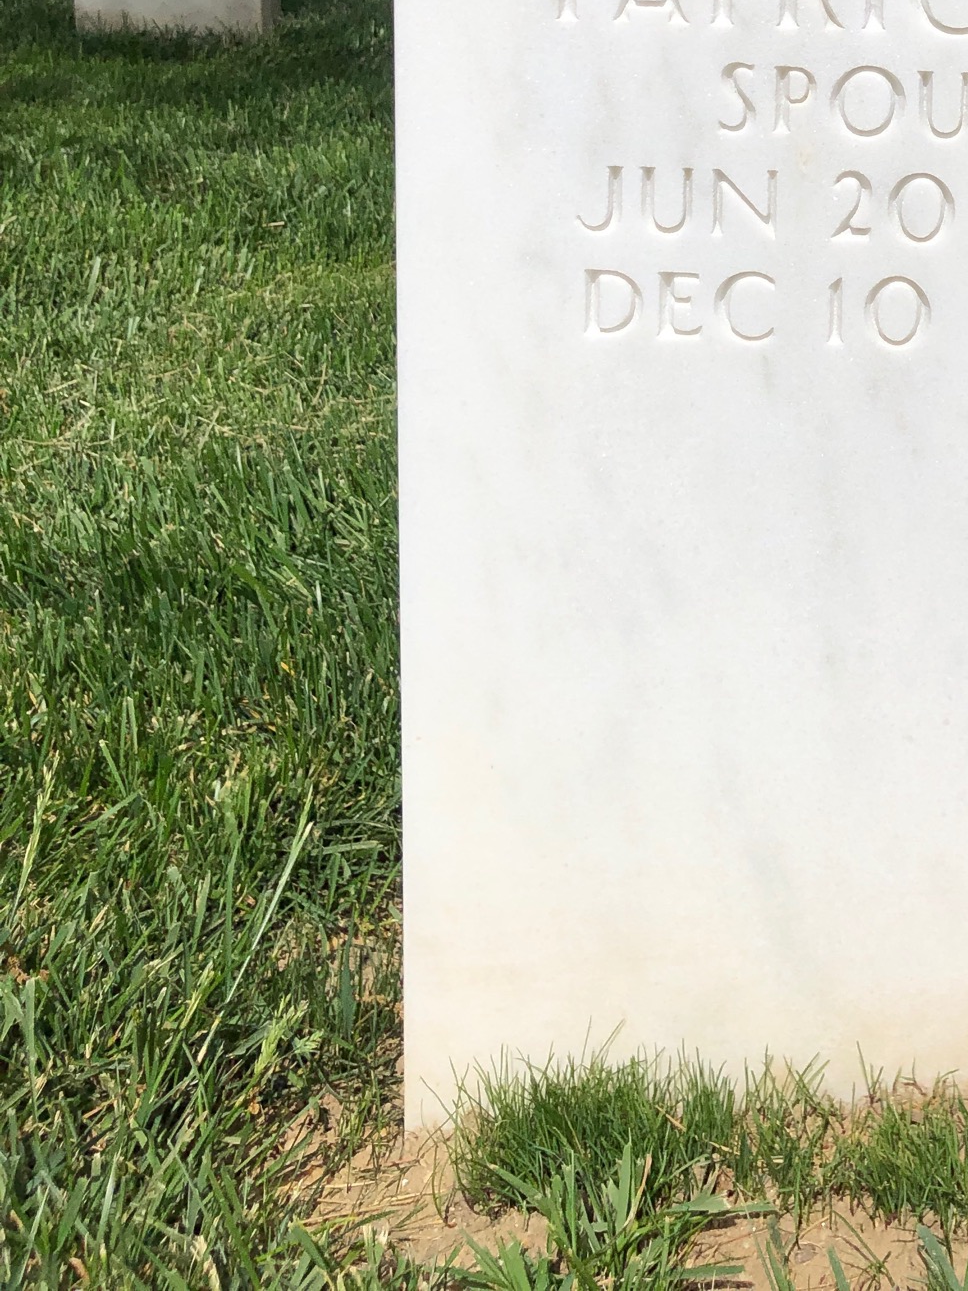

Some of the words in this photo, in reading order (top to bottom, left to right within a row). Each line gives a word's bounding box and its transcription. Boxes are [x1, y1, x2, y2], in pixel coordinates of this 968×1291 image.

[575, 164, 779, 237] JUN
[830, 169, 955, 243] 20
[583, 267, 777, 342] DEC
[826, 274, 933, 347] 10
